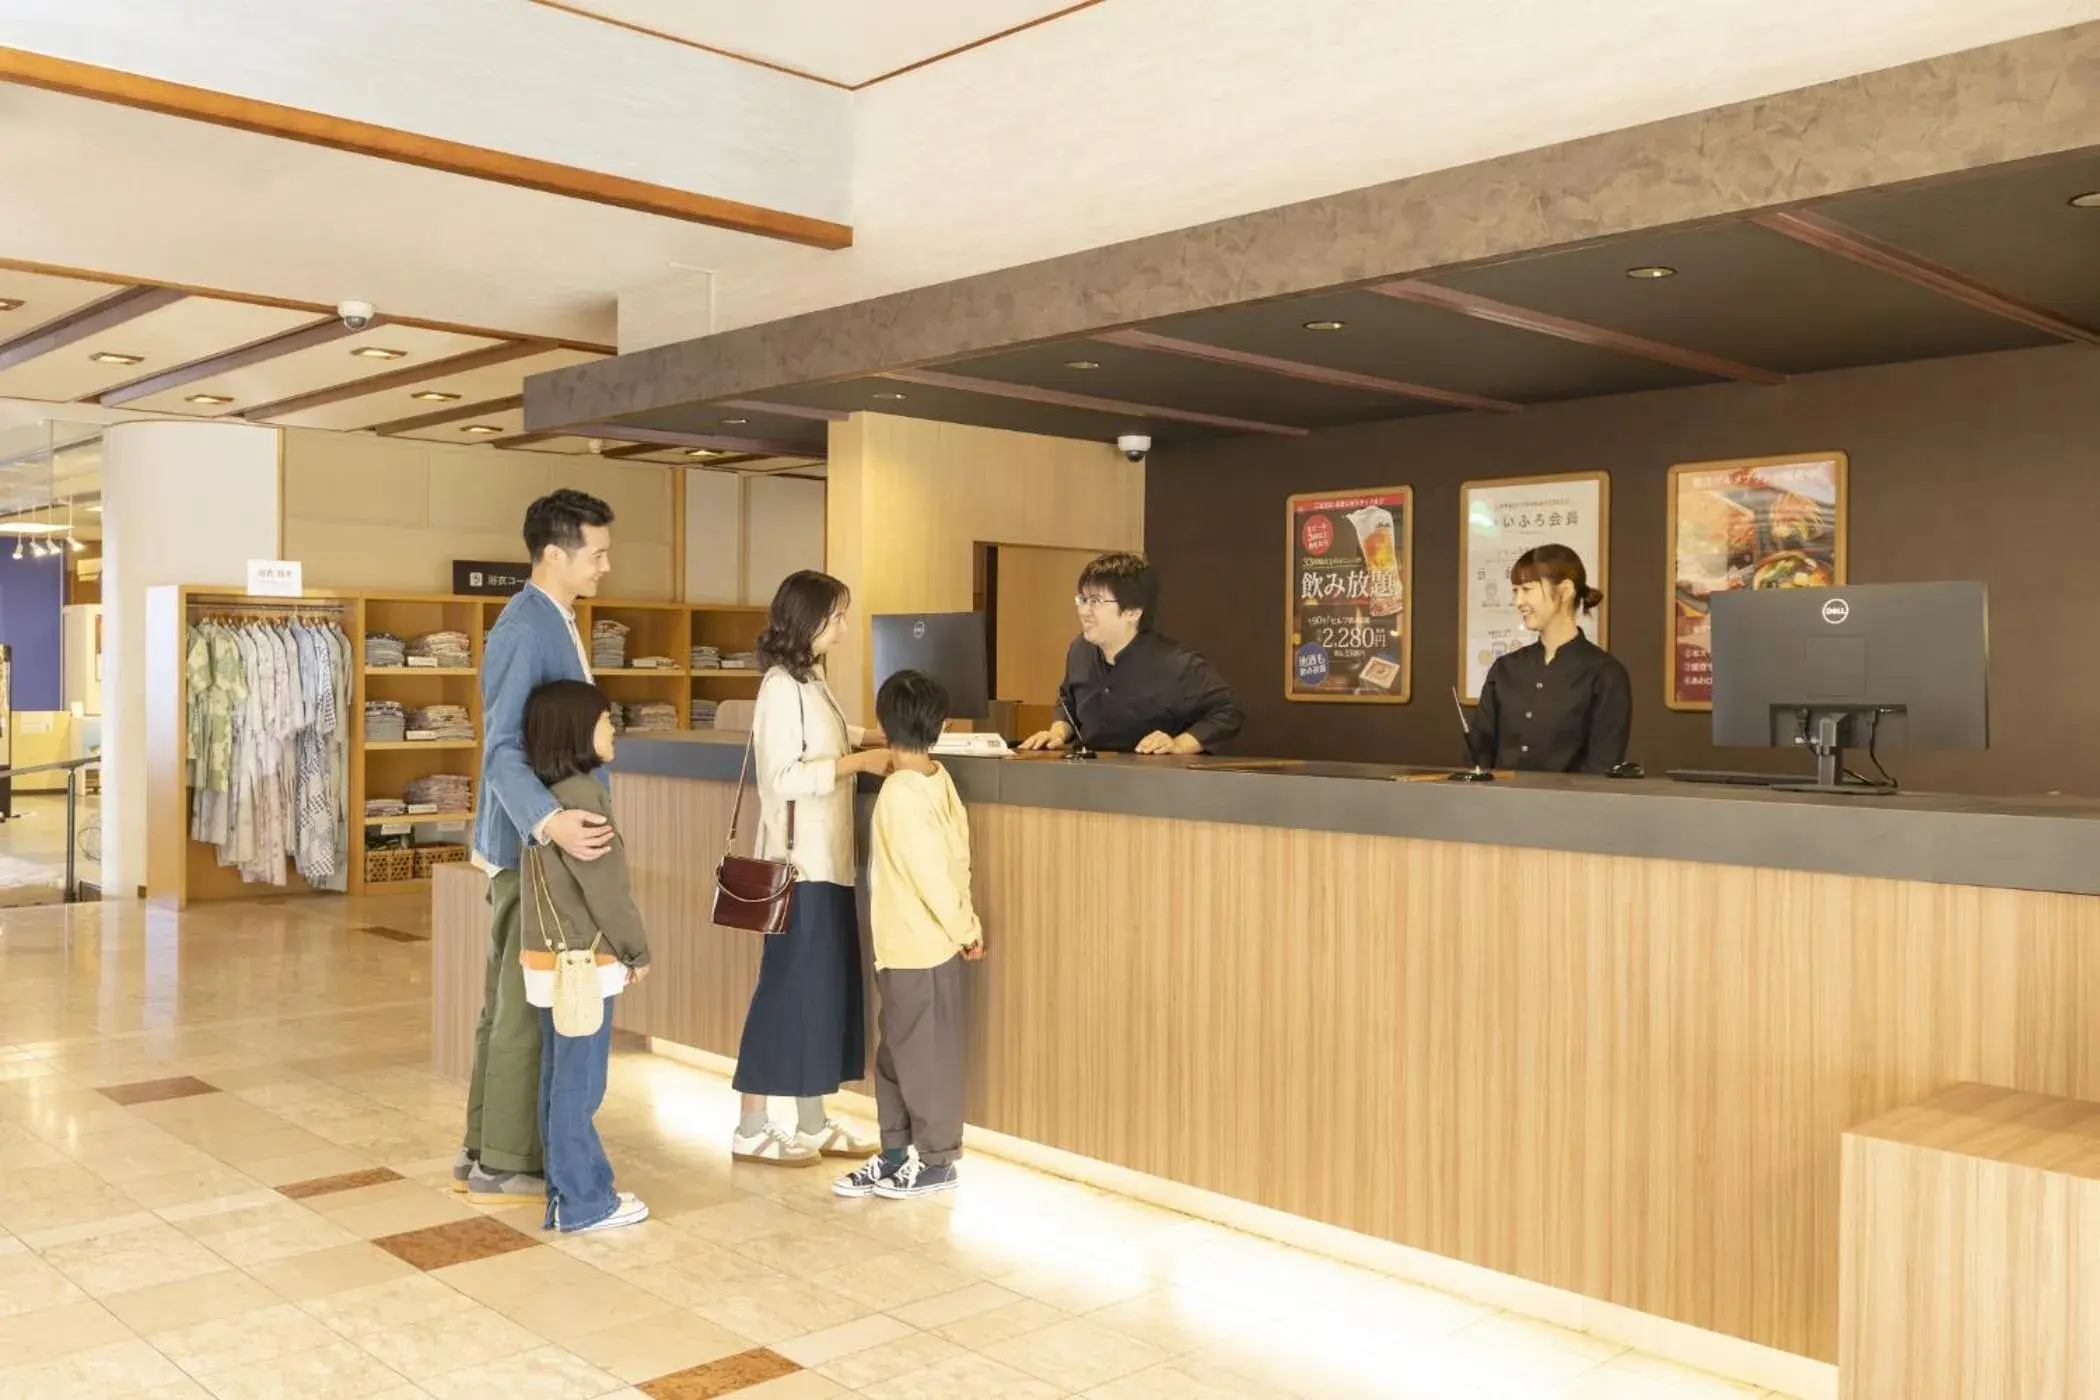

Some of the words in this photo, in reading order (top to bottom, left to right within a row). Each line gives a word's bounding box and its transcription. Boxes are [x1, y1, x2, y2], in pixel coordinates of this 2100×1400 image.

[1492, 511, 1578, 528] いふろ会員
[487, 574, 526, 586] 浴衣コー
[1302, 570, 1395, 598] 飲み放題
